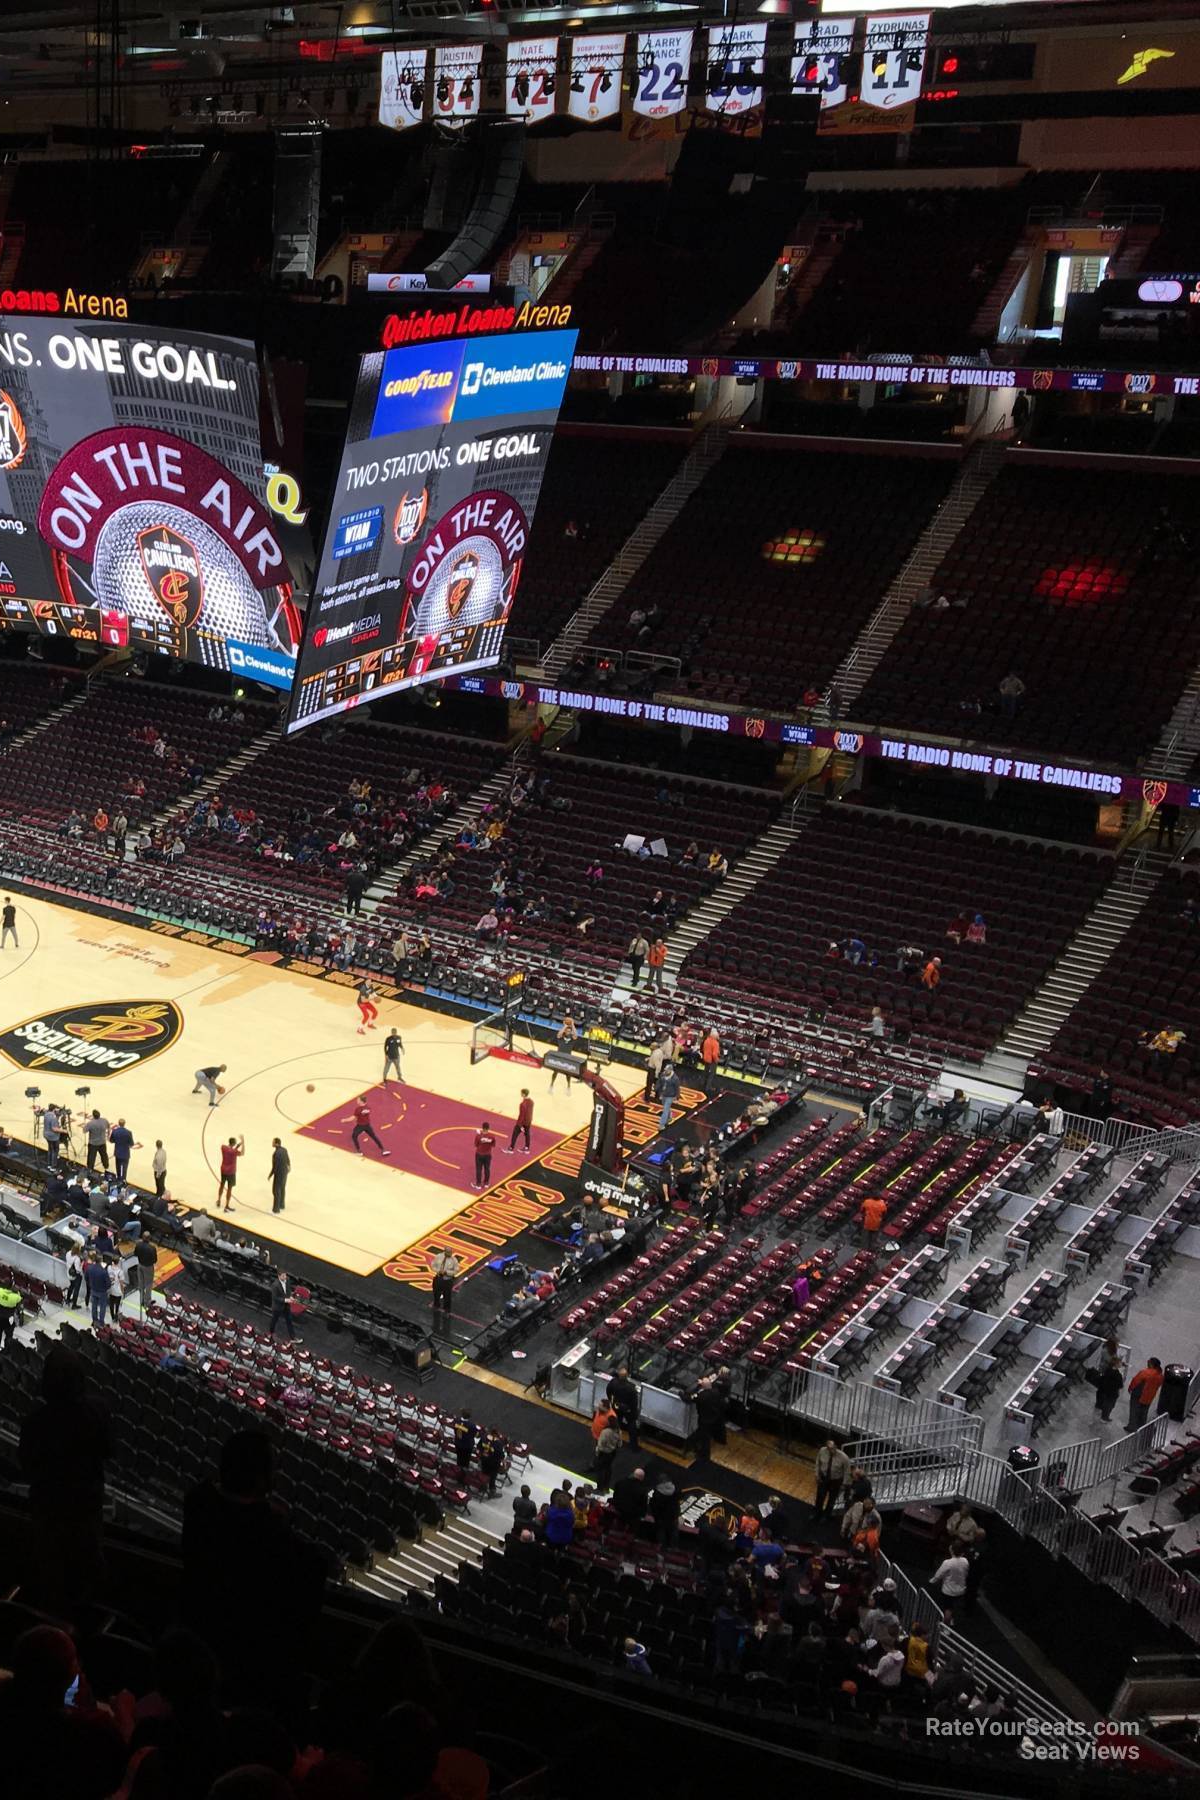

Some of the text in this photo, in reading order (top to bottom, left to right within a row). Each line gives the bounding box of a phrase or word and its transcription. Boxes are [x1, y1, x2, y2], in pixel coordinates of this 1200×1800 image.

[870, 20, 925, 33] ZYDRUNAS
[521, 45, 543, 55] NATE
[648, 37, 681, 48] LARRY
[443, 52, 474, 61] AUSTIN
[640, 62, 683, 101] 22
[872, 51, 909, 90] 11
[588, 66, 605, 103] 7
[64, 288, 128, 318] Arena
[382, 301, 572, 348] Quicken Loans Arena
[49, 334, 126, 375] ONE
[131, 341, 237, 391] GOAL.
[483, 361, 566, 387] Cleveland Clinic
[573, 355, 688, 373] HOME OF THE CAVALIERS
[816, 364, 1016, 386] THE RADIO HOME OF THE CAVALIERS
[385, 369, 453, 397] GOODYEAR
[1174, 378, 1199, 394] THE
[346, 434, 541, 491] TWO STATIONS. ONE GOAL.
[51, 441, 283, 577] ON THE AIR
[265, 473, 306, 524] Q
[344, 521, 371, 544] WTAM
[412, 499, 526, 589] ON THE AIR
[143, 547, 198, 577] CAVALIERS
[320, 597, 334, 611] both
[366, 582, 385, 596] season
[323, 572, 379, 596] Hear every game on
[46, 620, 56, 634] 0
[70, 627, 97, 640] 47:21
[109, 629, 119, 643] 0
[326, 614, 381, 642] iHeartMEDIA
[245, 654, 288, 677] Cleveland
[415, 659, 422, 674] 0
[366, 673, 374, 690] 0
[538, 688, 729, 732] THE RADIO HOME OF THE CAVALIERS
[788, 730, 808, 740] WTAM
[881, 739, 1122, 795] THE RADIO HOME OF THE CAVALIERS
[14, 1021, 140, 1069] CAVALIERS
[24, 1043, 85, 1067] CLEVELAND
[585, 1180, 640, 1207] drug mart
